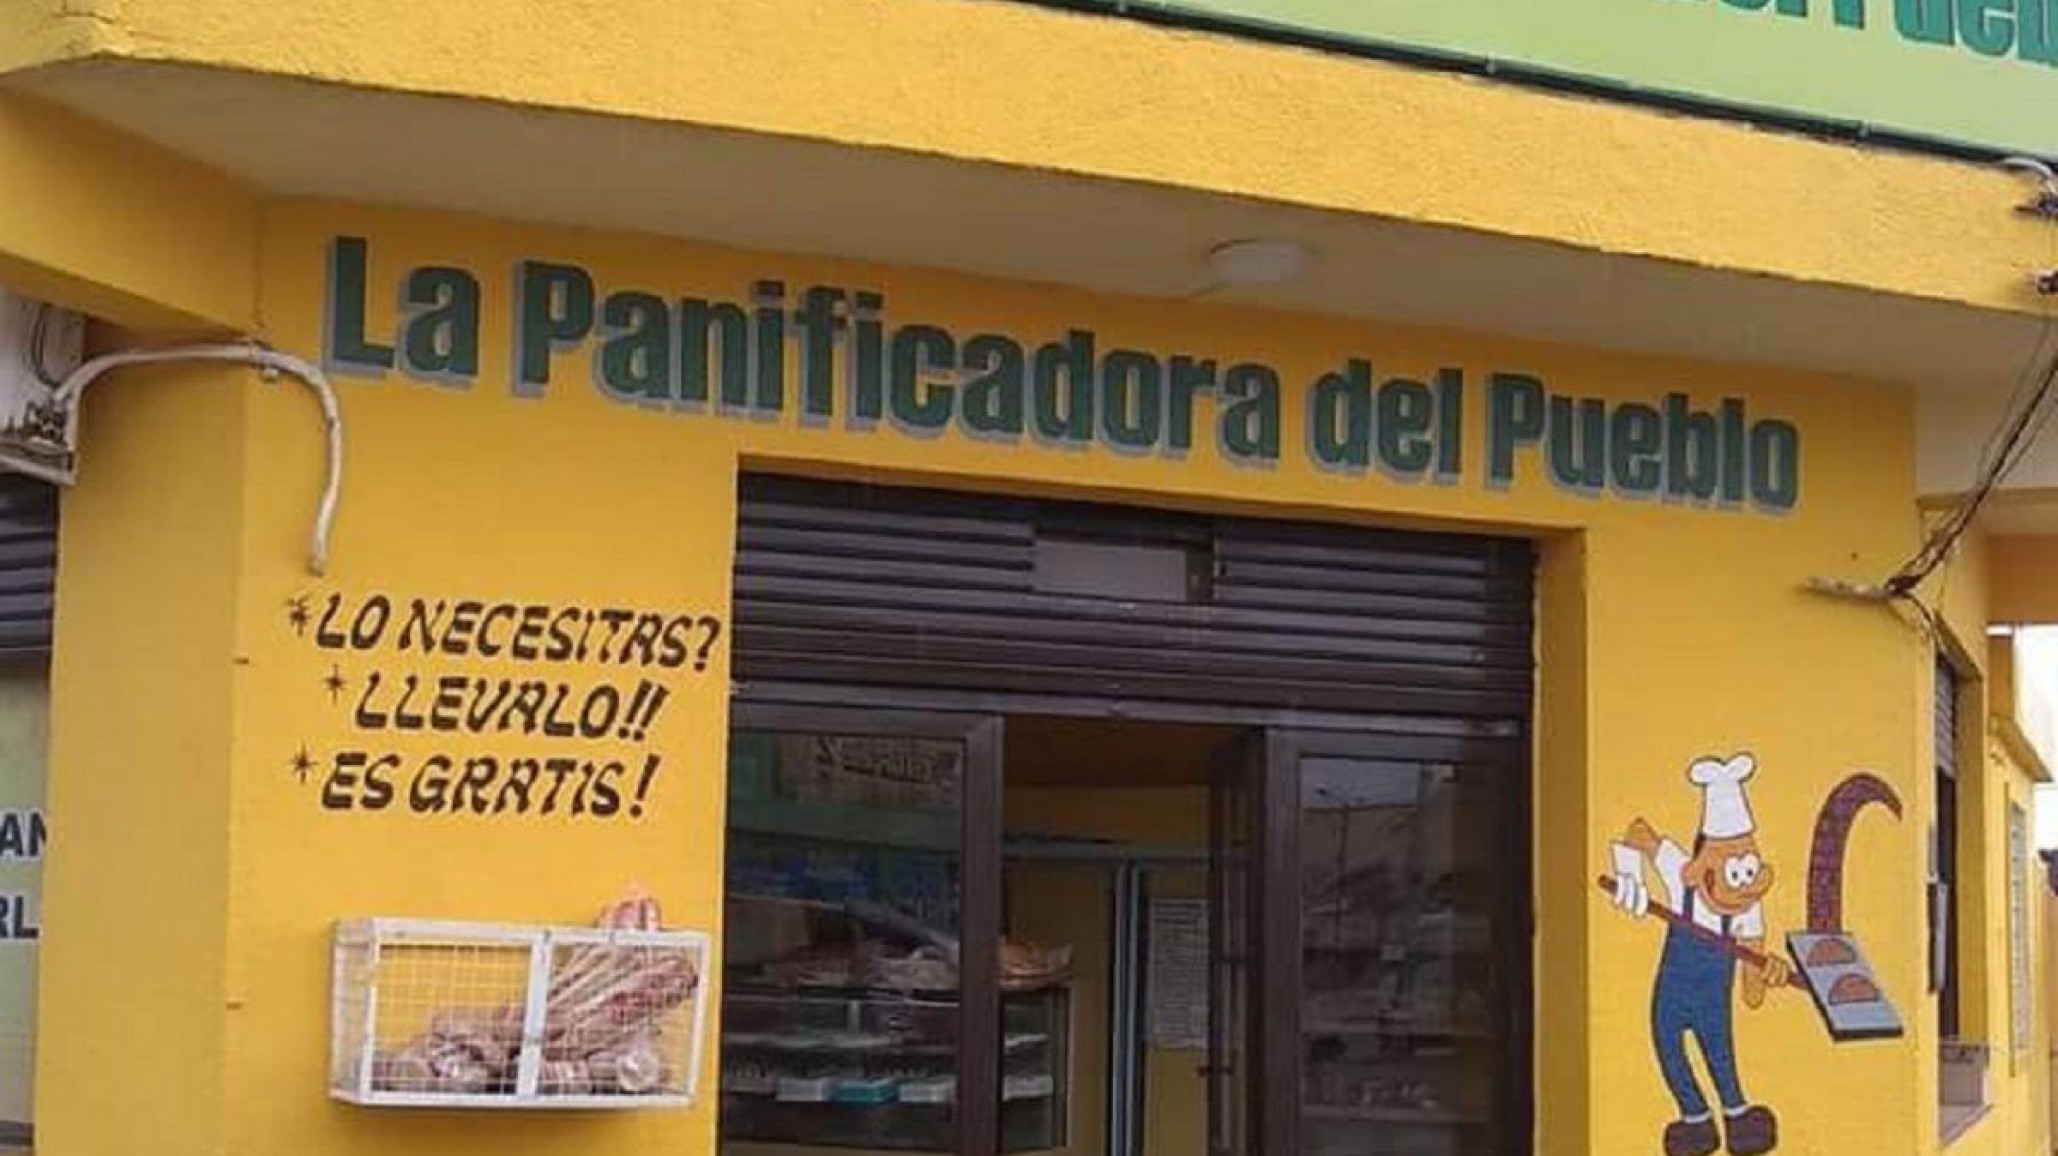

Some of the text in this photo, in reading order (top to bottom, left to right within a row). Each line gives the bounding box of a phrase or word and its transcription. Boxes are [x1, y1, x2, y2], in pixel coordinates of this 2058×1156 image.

[326, 236, 1800, 517] La Panificadora del Pueblo
[398, 598, 721, 672] NECESITAS?
[356, 671, 670, 741] LLEVALO!!
[321, 751, 661, 818] ES GRATIS!
